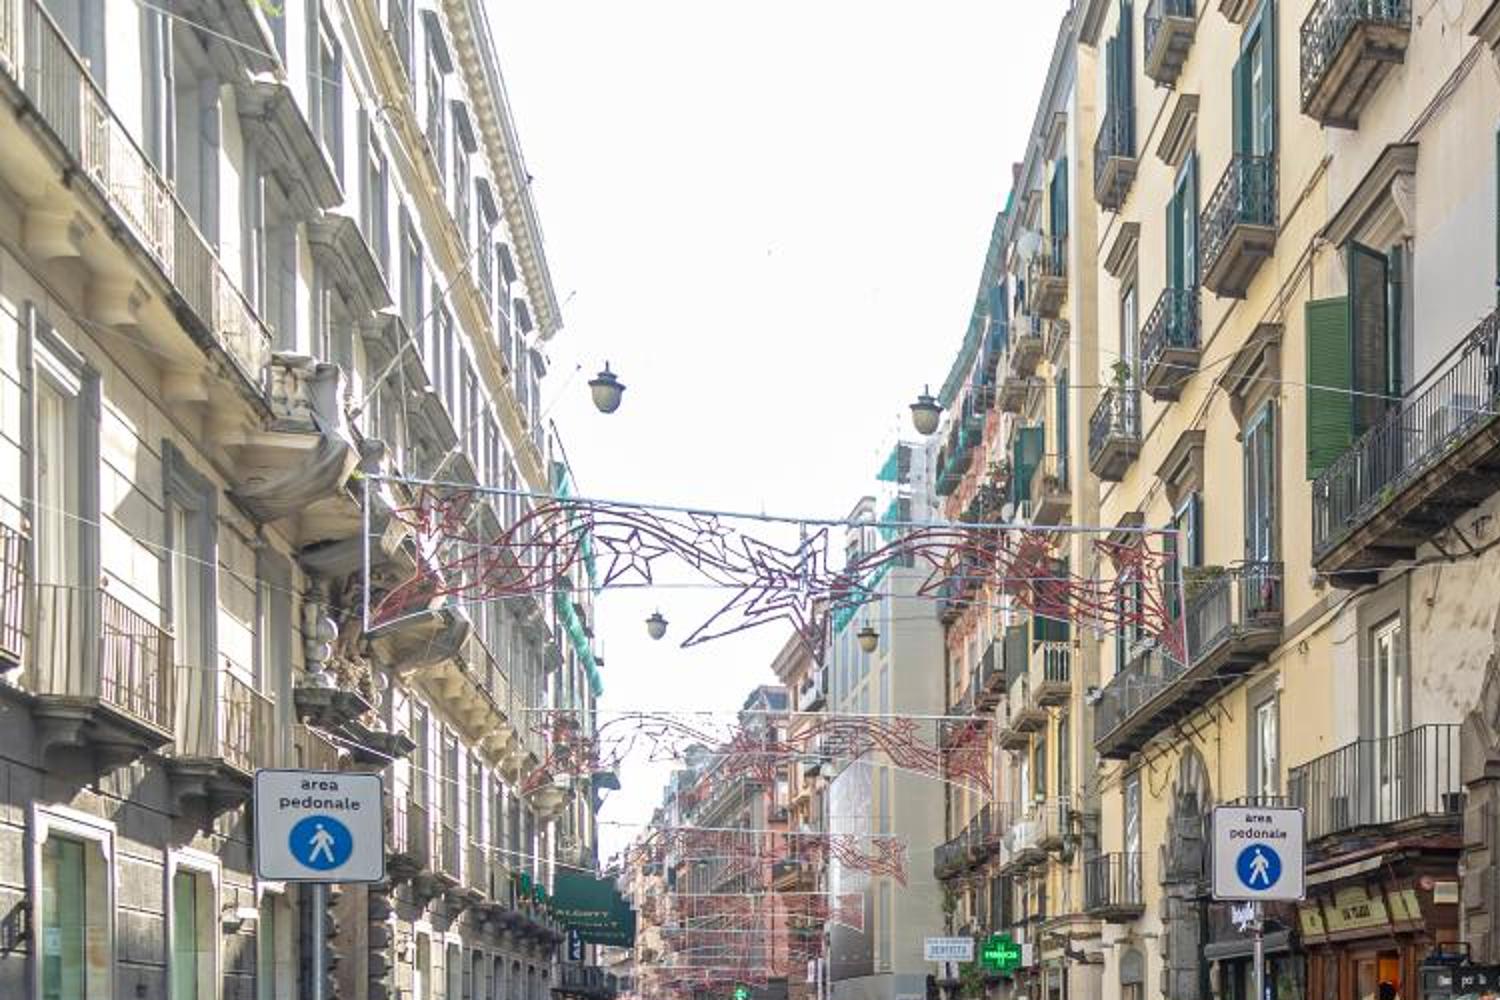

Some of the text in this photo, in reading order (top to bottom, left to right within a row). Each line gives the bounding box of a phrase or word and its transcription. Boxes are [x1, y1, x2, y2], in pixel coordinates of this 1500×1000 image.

[301, 780, 339, 791] area
[279, 796, 361, 812] pedonale
[1246, 814, 1273, 823] area
[1229, 827, 1287, 840] pedonale
